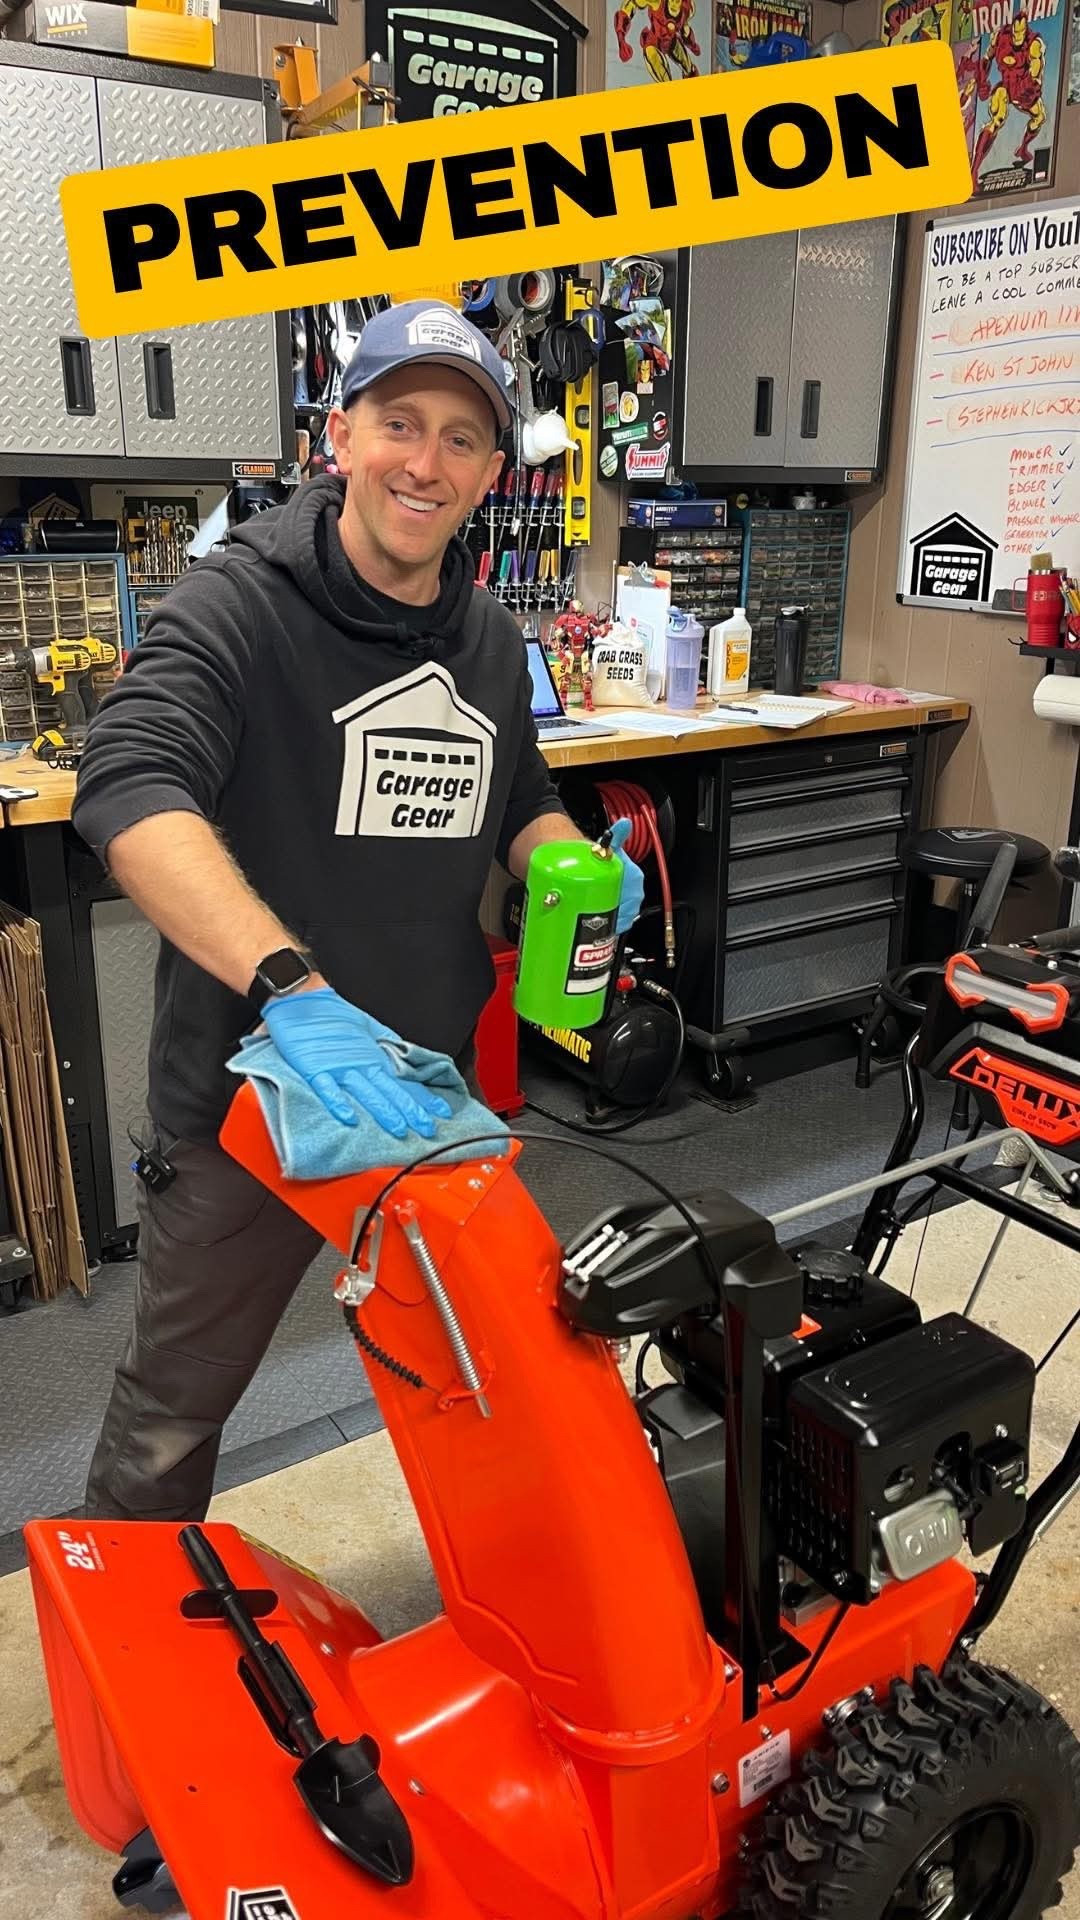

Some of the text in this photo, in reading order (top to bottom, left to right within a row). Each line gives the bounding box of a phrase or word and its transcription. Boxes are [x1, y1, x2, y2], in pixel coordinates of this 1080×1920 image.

[45, 3, 87, 26] WIX
[736, 8, 769, 41] IRON
[972, 0, 1014, 37] IRON
[407, 53, 545, 103] Garage
[932, 225, 1006, 267] SUBSCRIBE
[1009, 221, 1030, 256] ON
[937, 276, 954, 291] TO
[961, 271, 977, 287] BE
[985, 271, 991, 282] A
[998, 263, 1023, 282] TOP
[931, 293, 967, 314] LEAVE
[975, 291, 983, 305] A
[992, 287, 1027, 301] COOL
[964, 350, 1074, 384] KEN ST JOHN
[627, 446, 668, 479] SUMMIT
[1010, 445, 1053, 463] MOWER
[1009, 461, 1065, 479] TRIMMER
[1008, 479, 1047, 496] EDGER
[136, 500, 188, 523] Jeep
[1006, 515, 1045, 527] PRESSURE
[1004, 529, 1050, 541] GENERATOR
[1003, 544, 1033, 554] OTHER
[924, 564, 978, 582] Garage
[932, 581, 968, 596] Gear
[619, 650, 643, 665] GRASS
[606, 666, 634, 681] SEEDS
[376, 769, 474, 802] Garage
[391, 803, 456, 829] Gear
[541, 1024, 592, 1064] NEUMATIC
